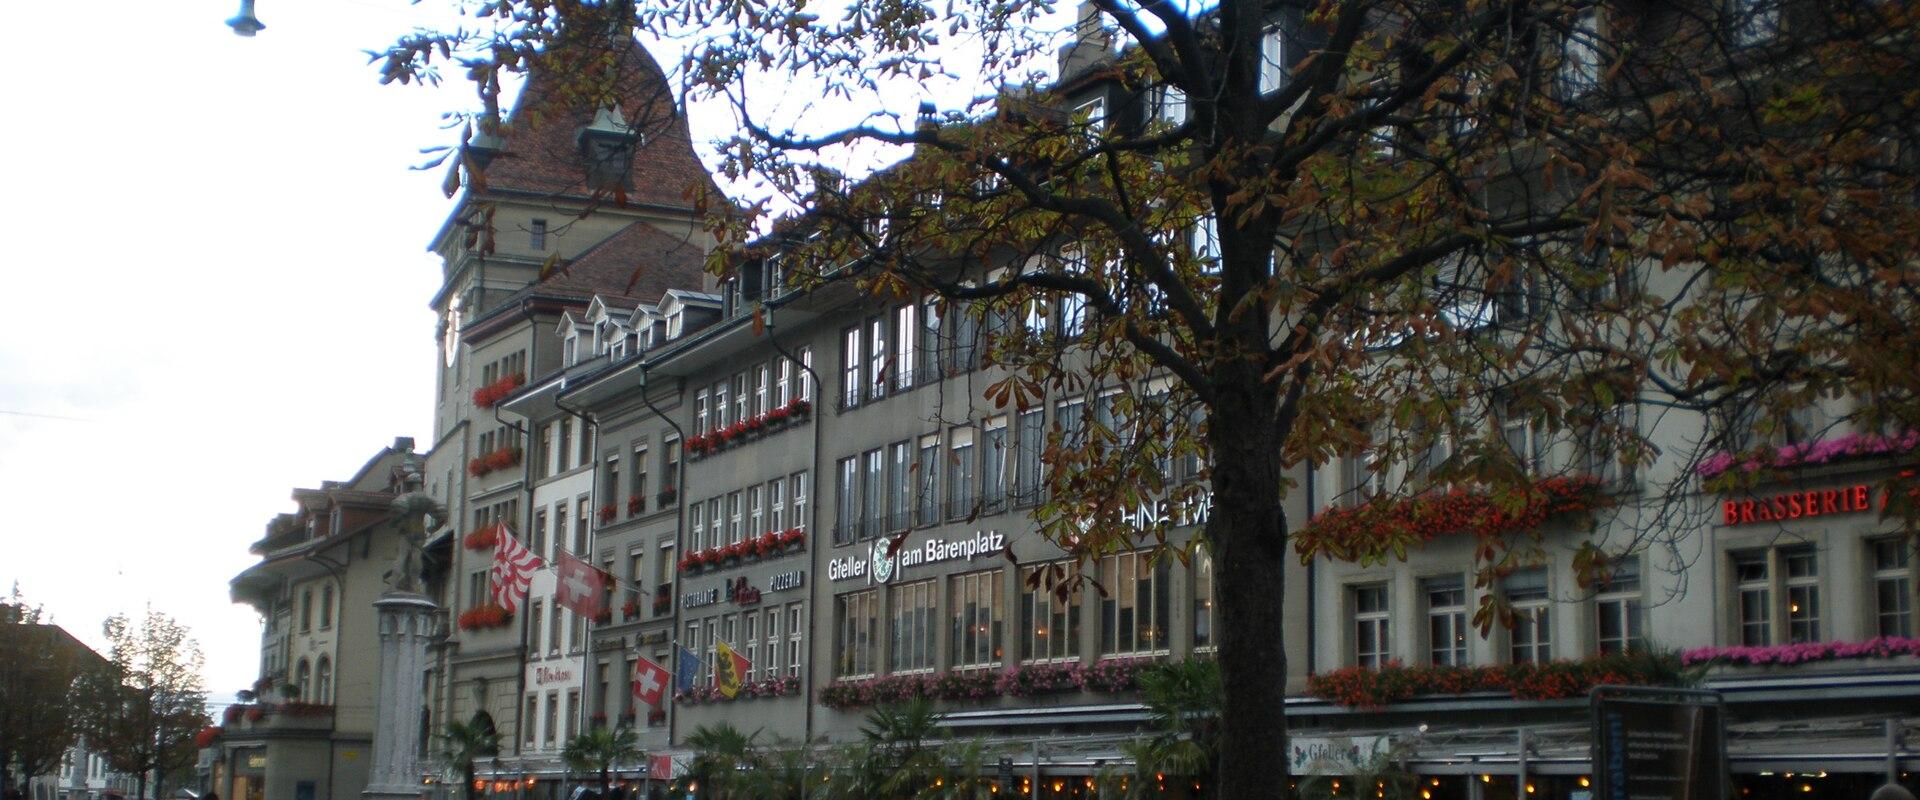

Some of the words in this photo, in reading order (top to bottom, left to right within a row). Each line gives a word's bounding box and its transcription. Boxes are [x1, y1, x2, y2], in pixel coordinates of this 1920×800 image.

[1723, 484, 1870, 527] BRASSERIE
[828, 558, 867, 581] Gfeller
[902, 547, 922, 567] am
[926, 530, 1004, 562] Bärenplatz
[768, 571, 802, 591] PIZZERIA
